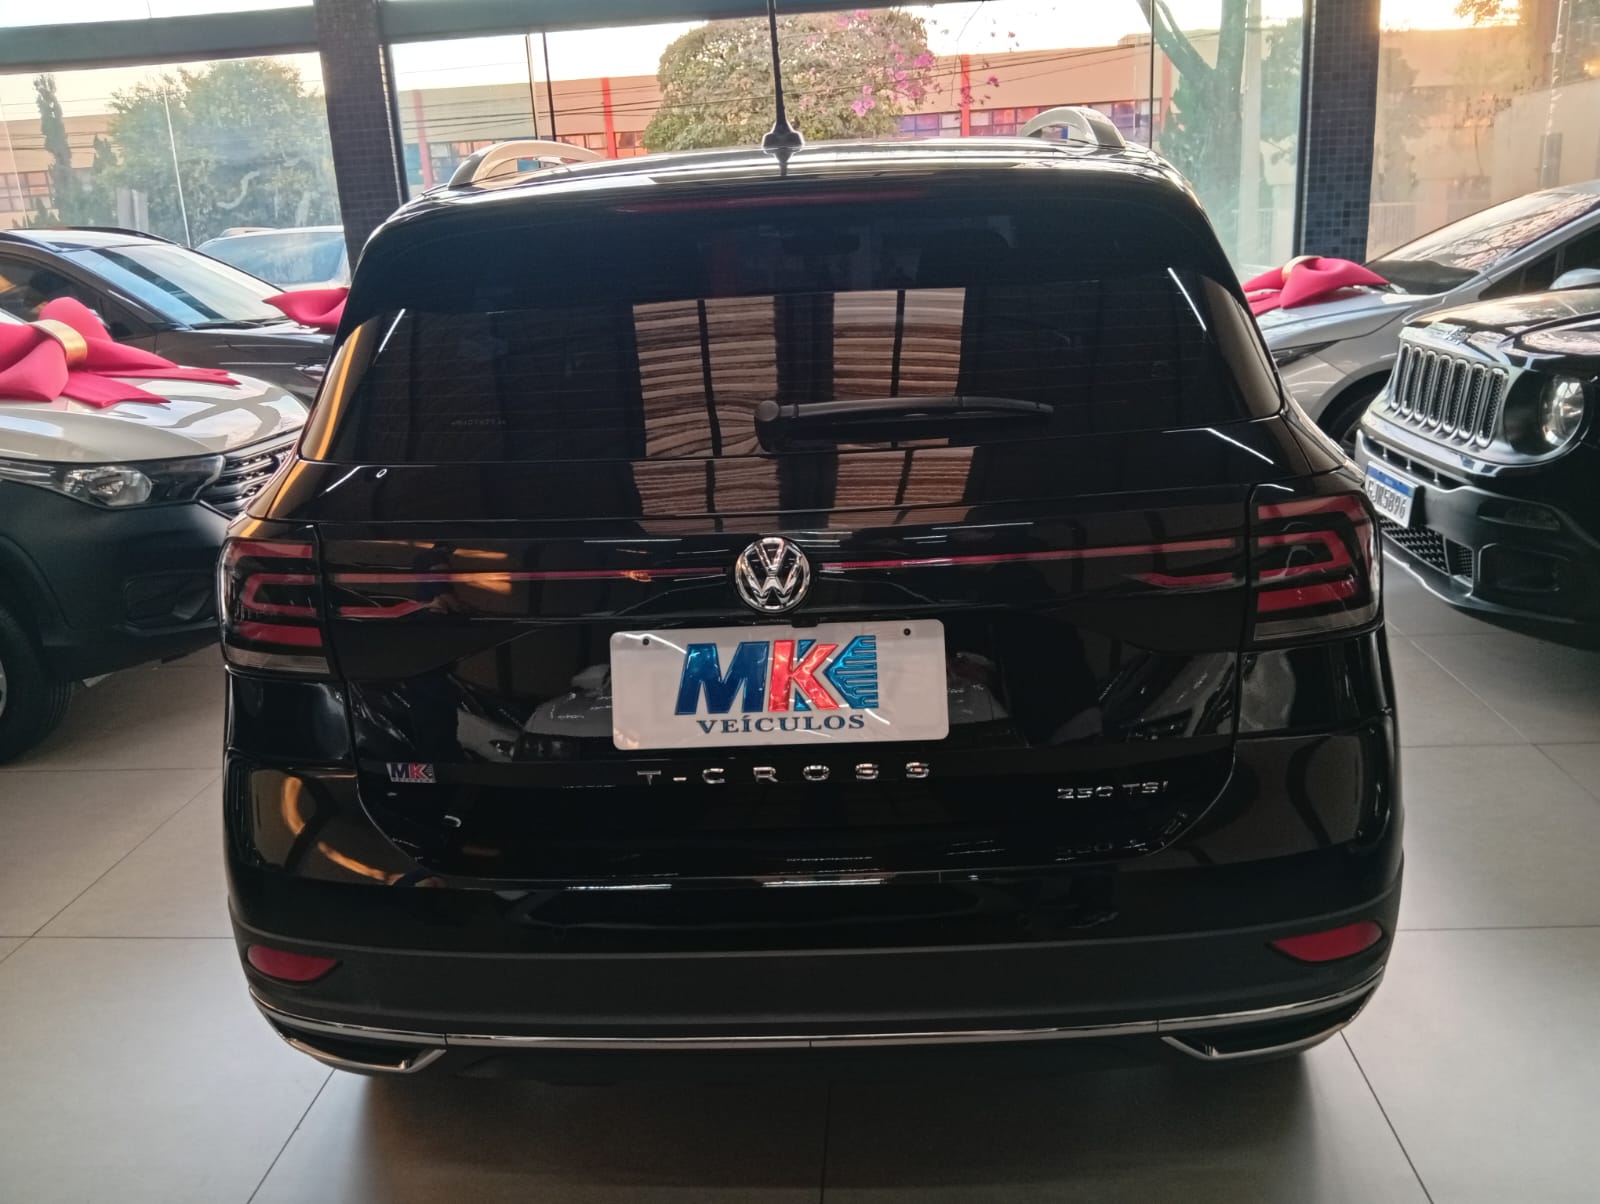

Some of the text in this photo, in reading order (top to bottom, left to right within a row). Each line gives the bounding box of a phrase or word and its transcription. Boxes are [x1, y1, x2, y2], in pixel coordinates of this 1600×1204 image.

[735, 537, 811, 613] VW
[675, 638, 842, 716] MK
[697, 714, 865, 734] VEÍCULOS
[390, 762, 428, 780] MK
[636, 761, 931, 785] T-CROSS
[1122, 780, 1169, 796] TSI
